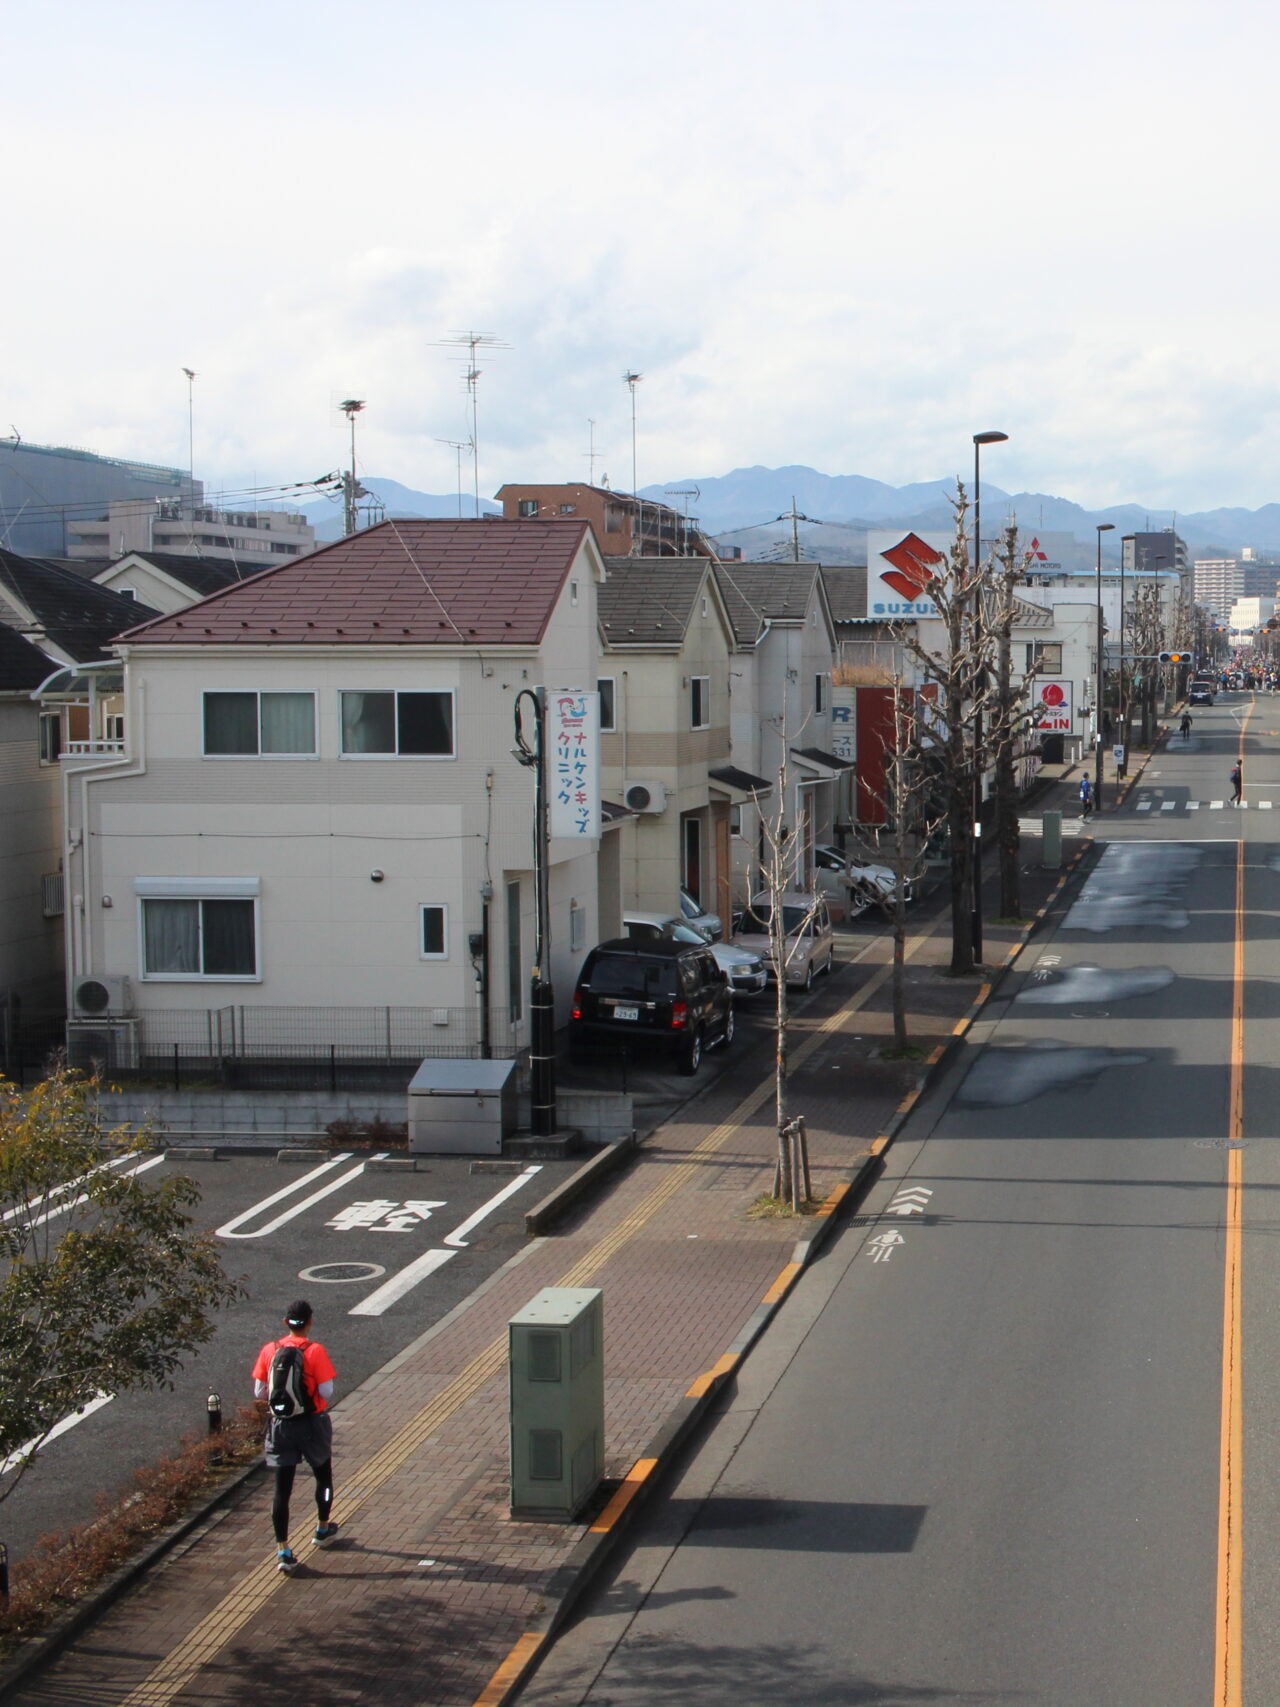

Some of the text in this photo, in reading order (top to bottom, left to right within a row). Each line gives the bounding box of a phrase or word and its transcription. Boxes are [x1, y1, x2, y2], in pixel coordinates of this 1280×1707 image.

[1054, 719, 1069, 729] IN
[558, 731, 572, 805] クリニック
[574, 732, 589, 833] ナルケンキッズ
[324, 1199, 447, 1233] 軽
